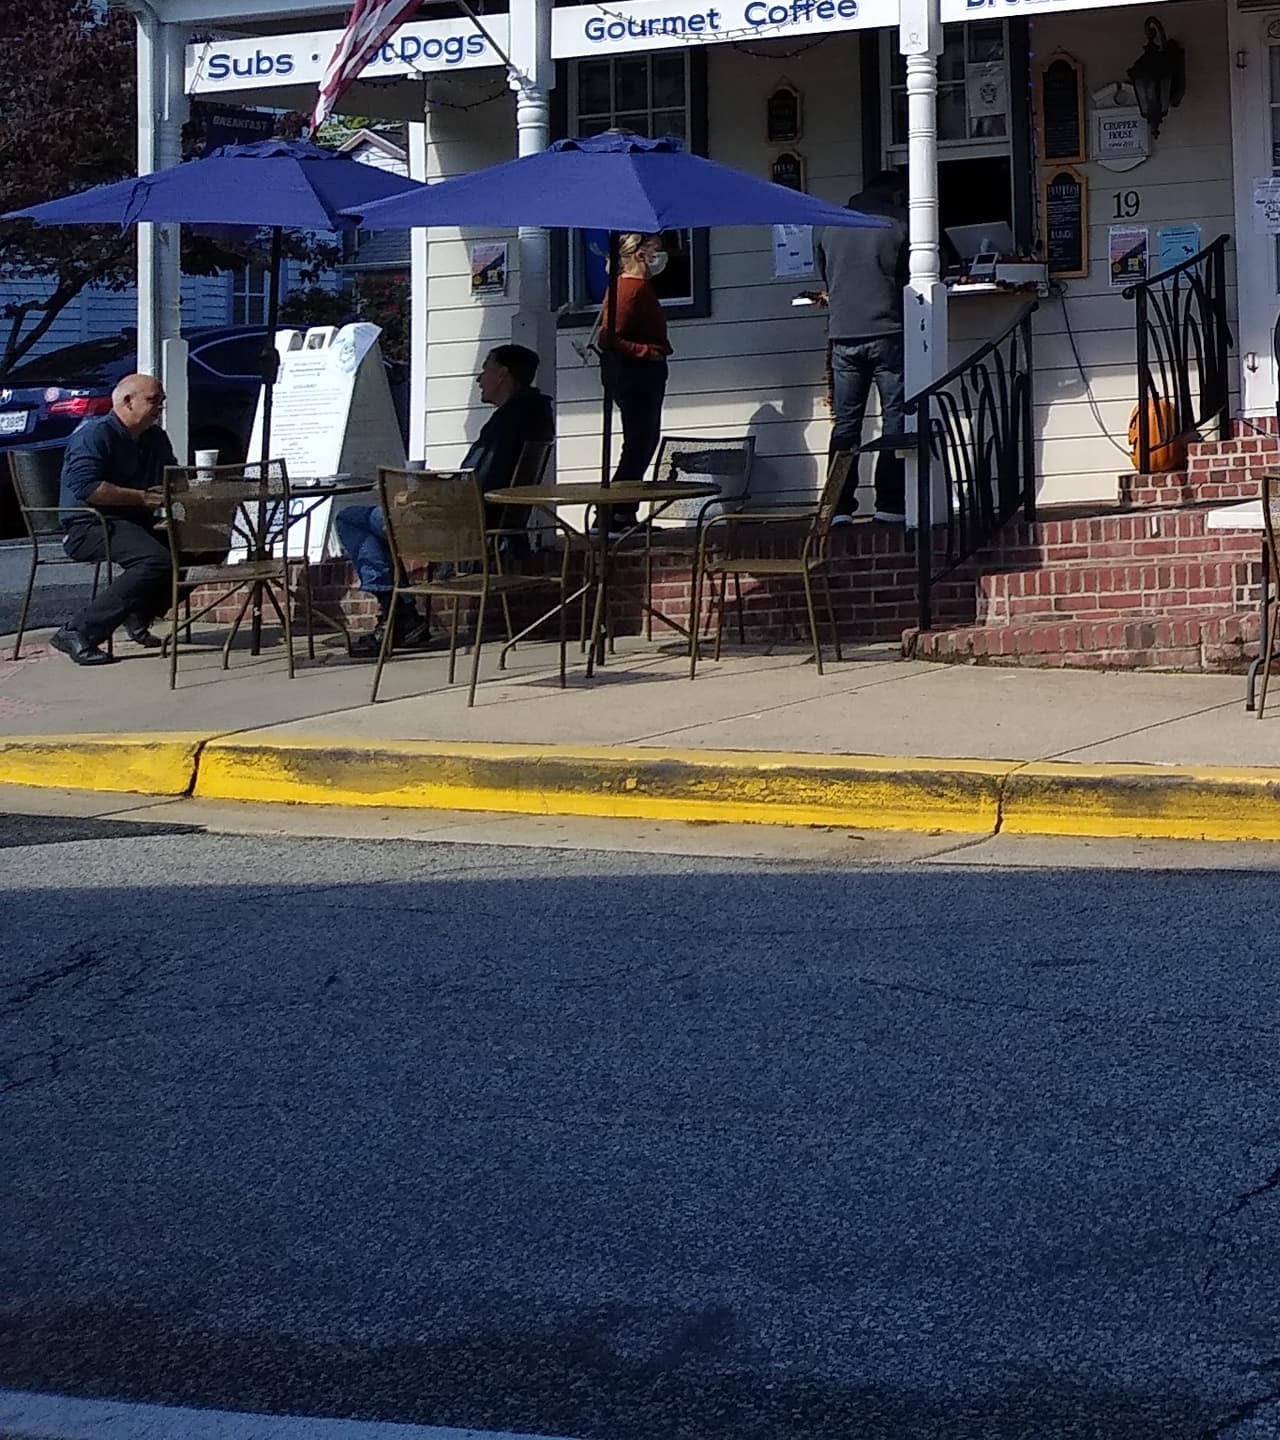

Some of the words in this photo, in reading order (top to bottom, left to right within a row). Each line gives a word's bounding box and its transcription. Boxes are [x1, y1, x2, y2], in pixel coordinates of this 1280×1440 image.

[584, 7, 720, 42] Gourmet
[207, 49, 294, 78] Subs
[400, 33, 485, 64] Dogs
[1112, 190, 1141, 219] 19
